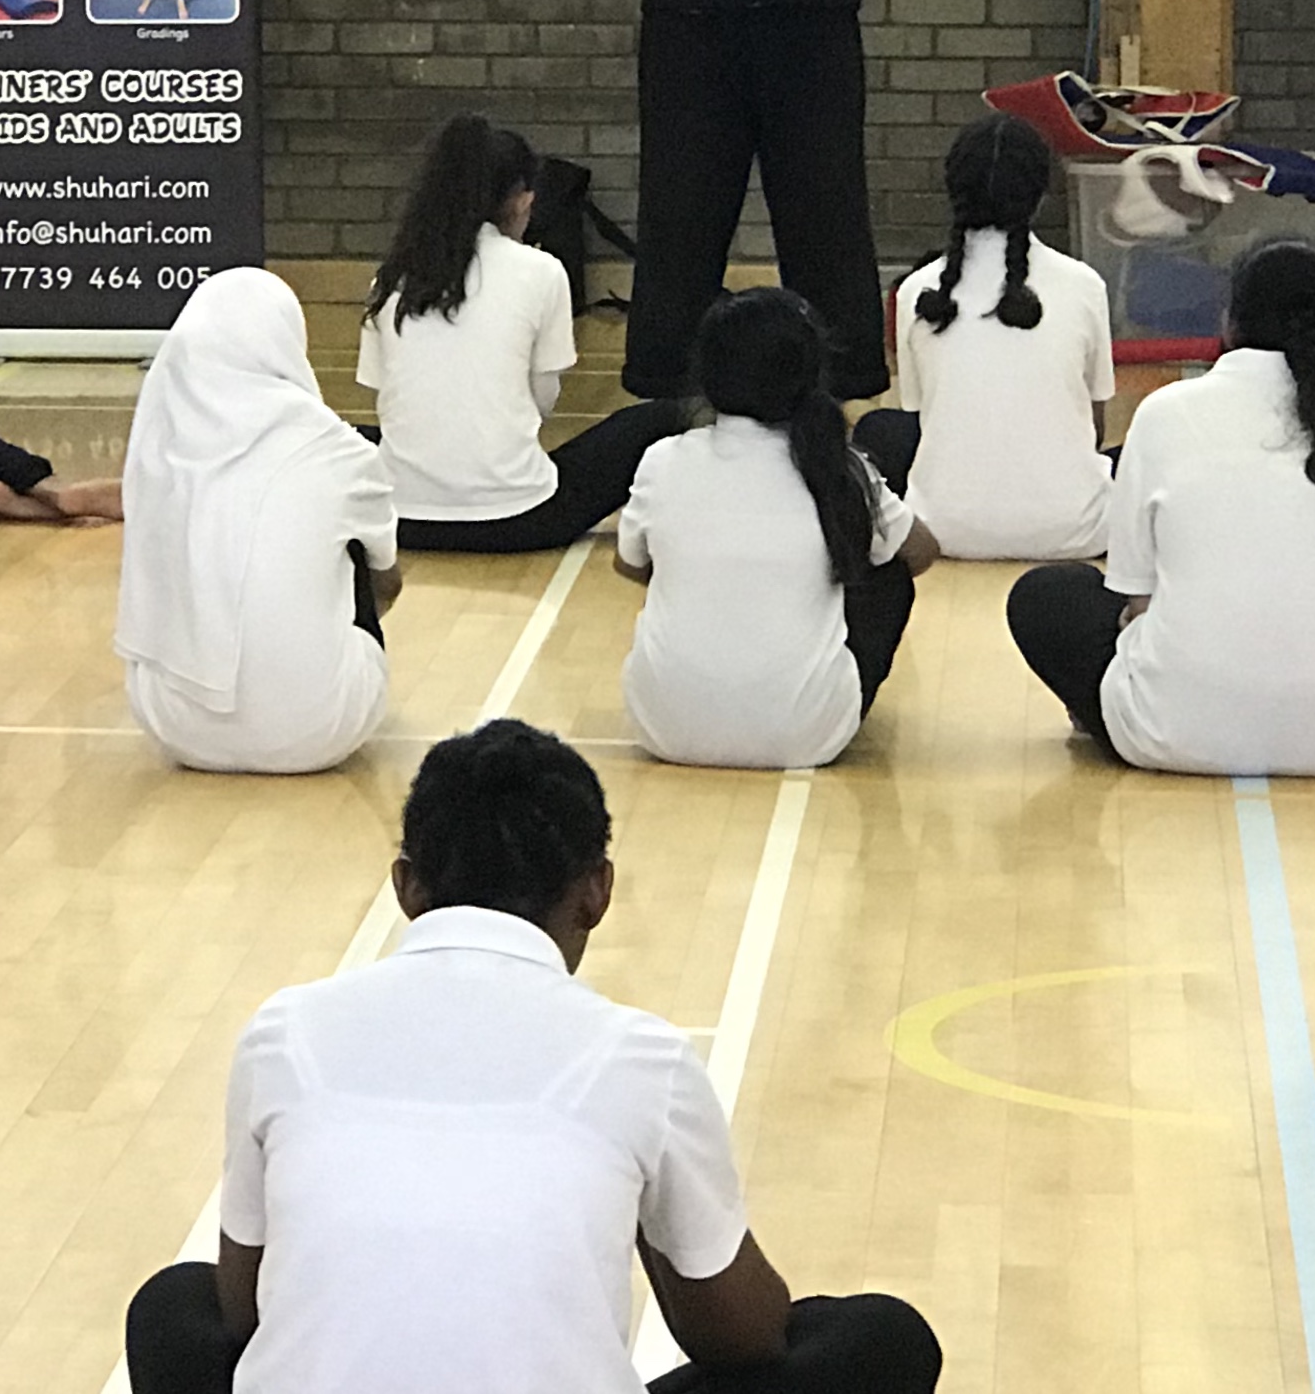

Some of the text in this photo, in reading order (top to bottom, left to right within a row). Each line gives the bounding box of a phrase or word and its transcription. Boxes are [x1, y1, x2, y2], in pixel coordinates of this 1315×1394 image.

[136, 27, 189, 42] Gradings
[100, 68, 243, 104] COURSES
[55, 112, 123, 144] AND
[128, 112, 242, 144] ADULTS
[88, 266, 142, 290] 464
